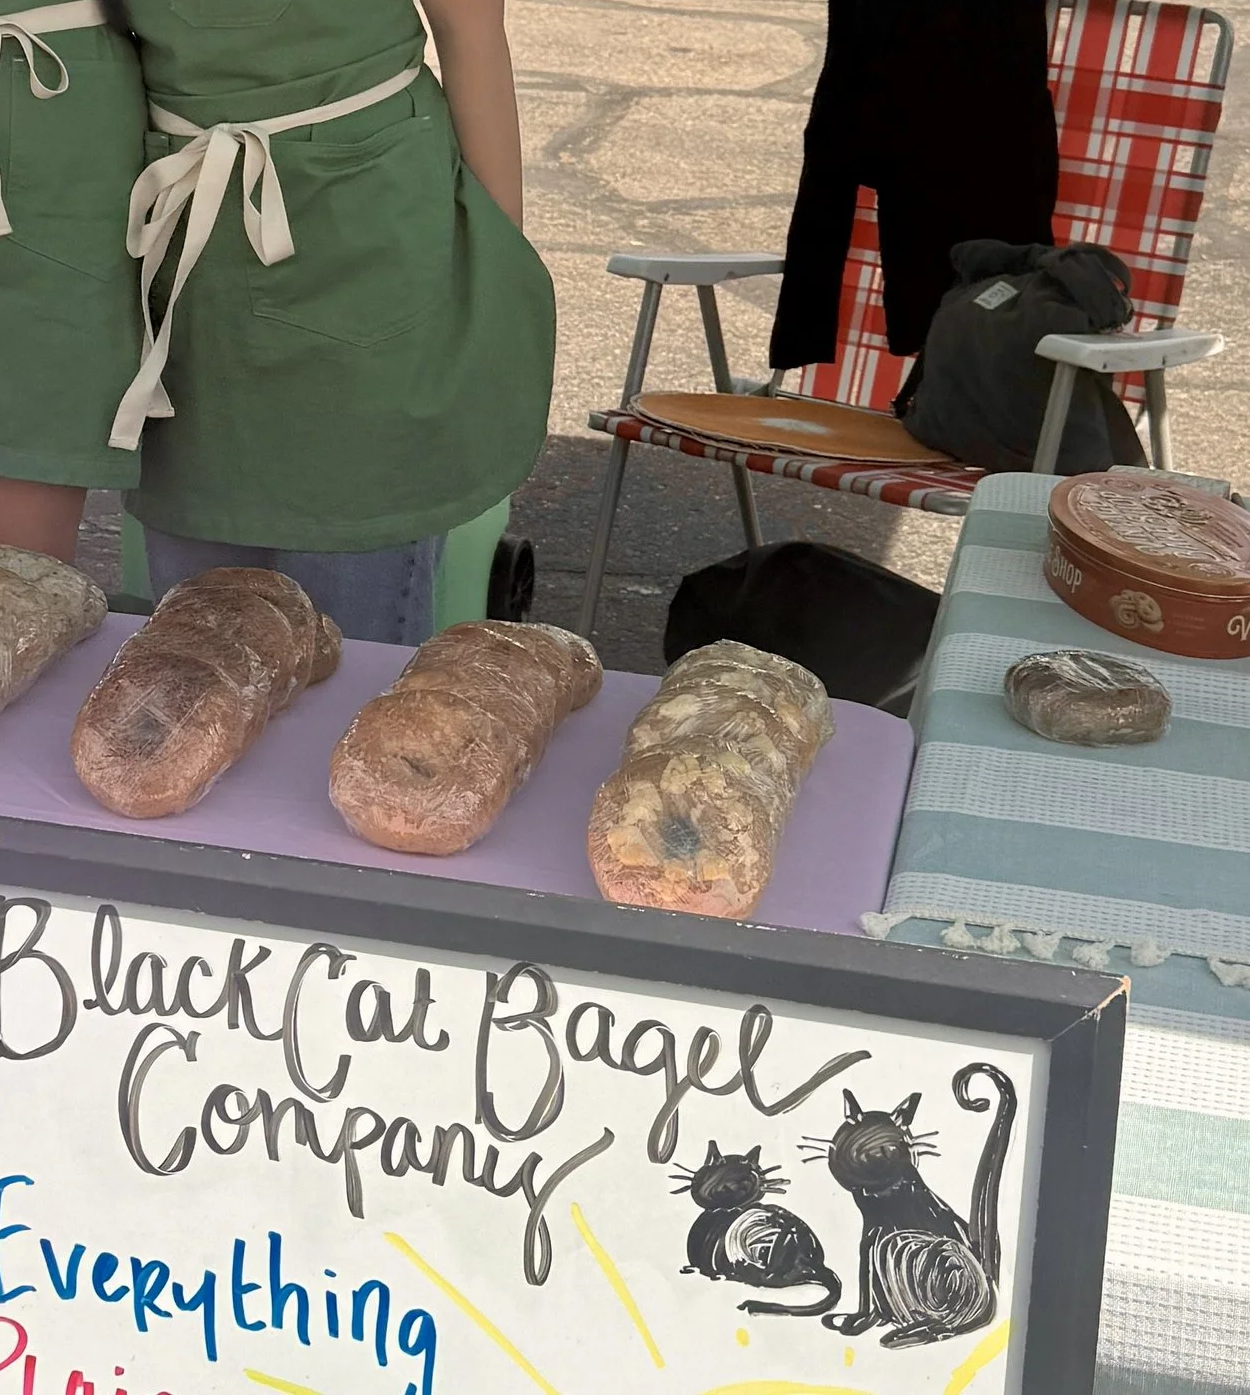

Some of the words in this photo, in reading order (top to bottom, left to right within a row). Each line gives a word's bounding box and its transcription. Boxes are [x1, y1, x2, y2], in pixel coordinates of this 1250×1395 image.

[117, 1023, 615, 1287] Company
[283, 942, 450, 1103] Cat
[475, 962, 872, 1164] Bagel
